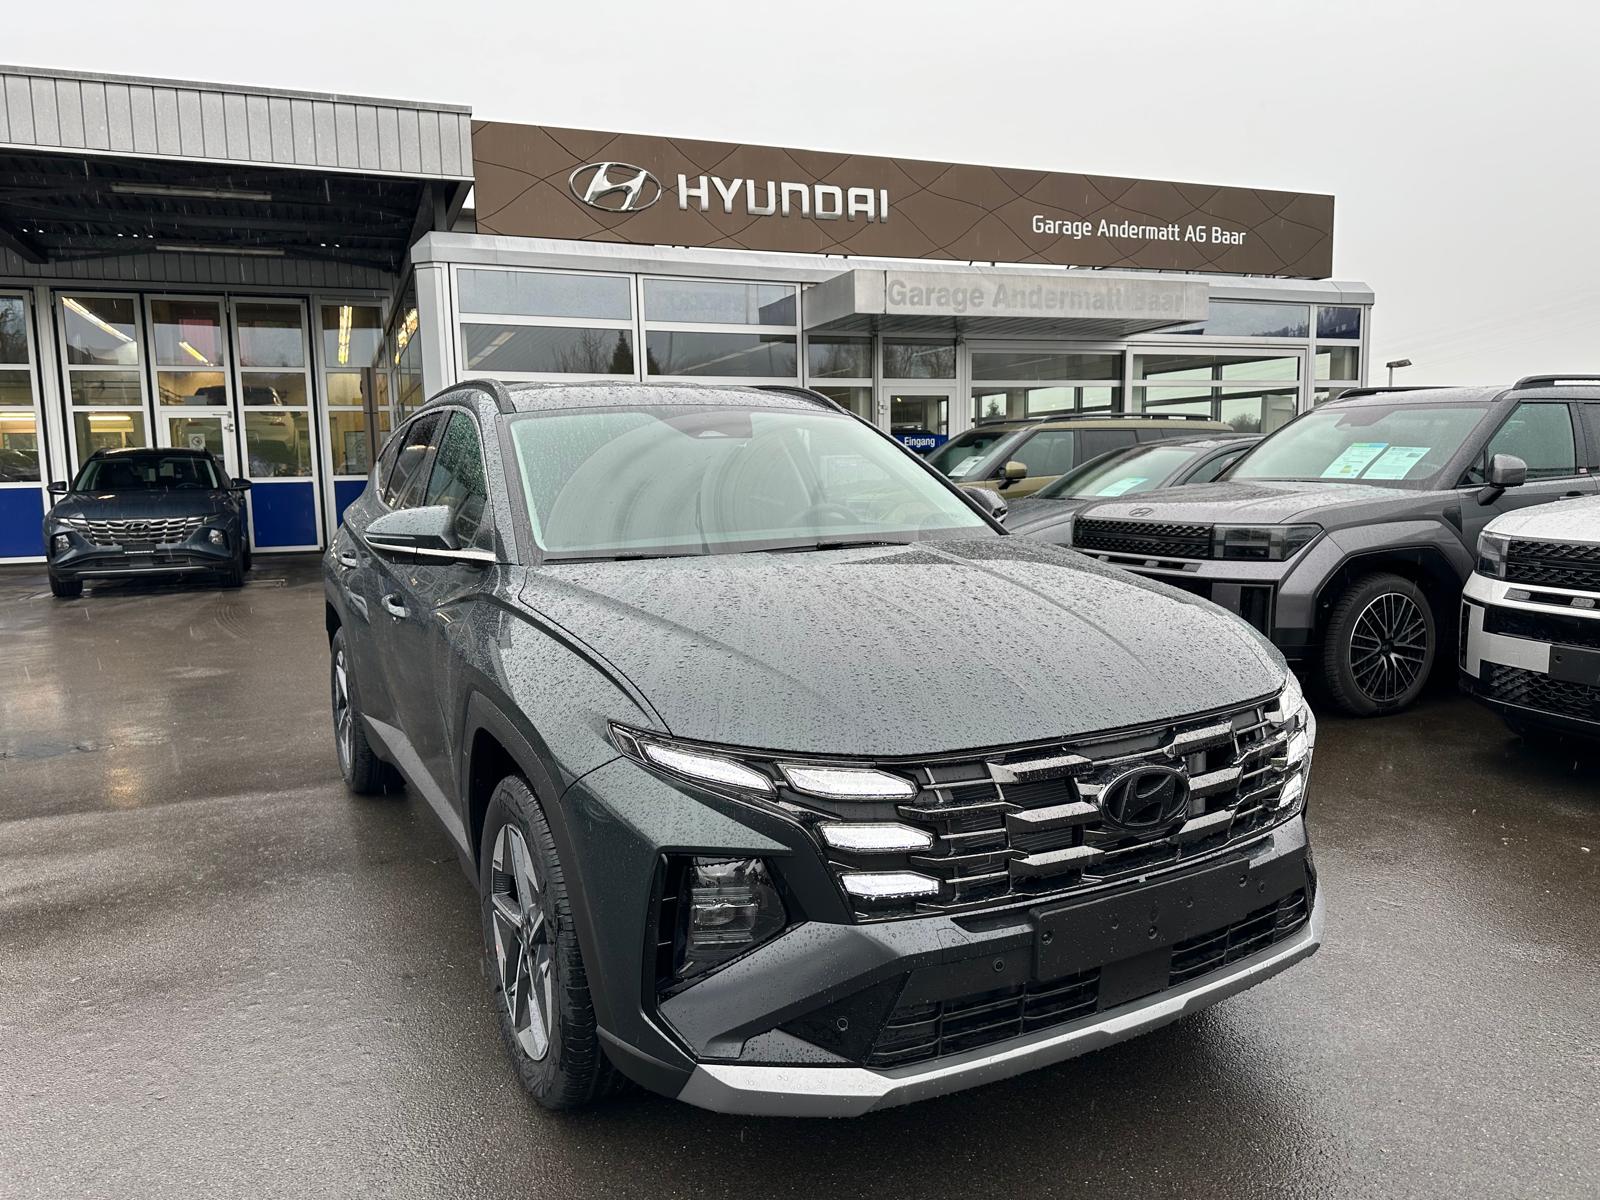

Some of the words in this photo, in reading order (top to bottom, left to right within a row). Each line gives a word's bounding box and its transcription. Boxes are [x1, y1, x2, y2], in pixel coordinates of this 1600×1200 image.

[677, 173, 888, 223] HYUNDAI
[1032, 214, 1093, 240] Garage
[1097, 218, 1181, 241] Andermatt
[1184, 224, 1207, 243] AG
[1211, 226, 1247, 245] Baar
[888, 279, 985, 314] Garage
[992, 282, 1124, 311] Andermatt
[904, 436, 936, 448] Eingang
